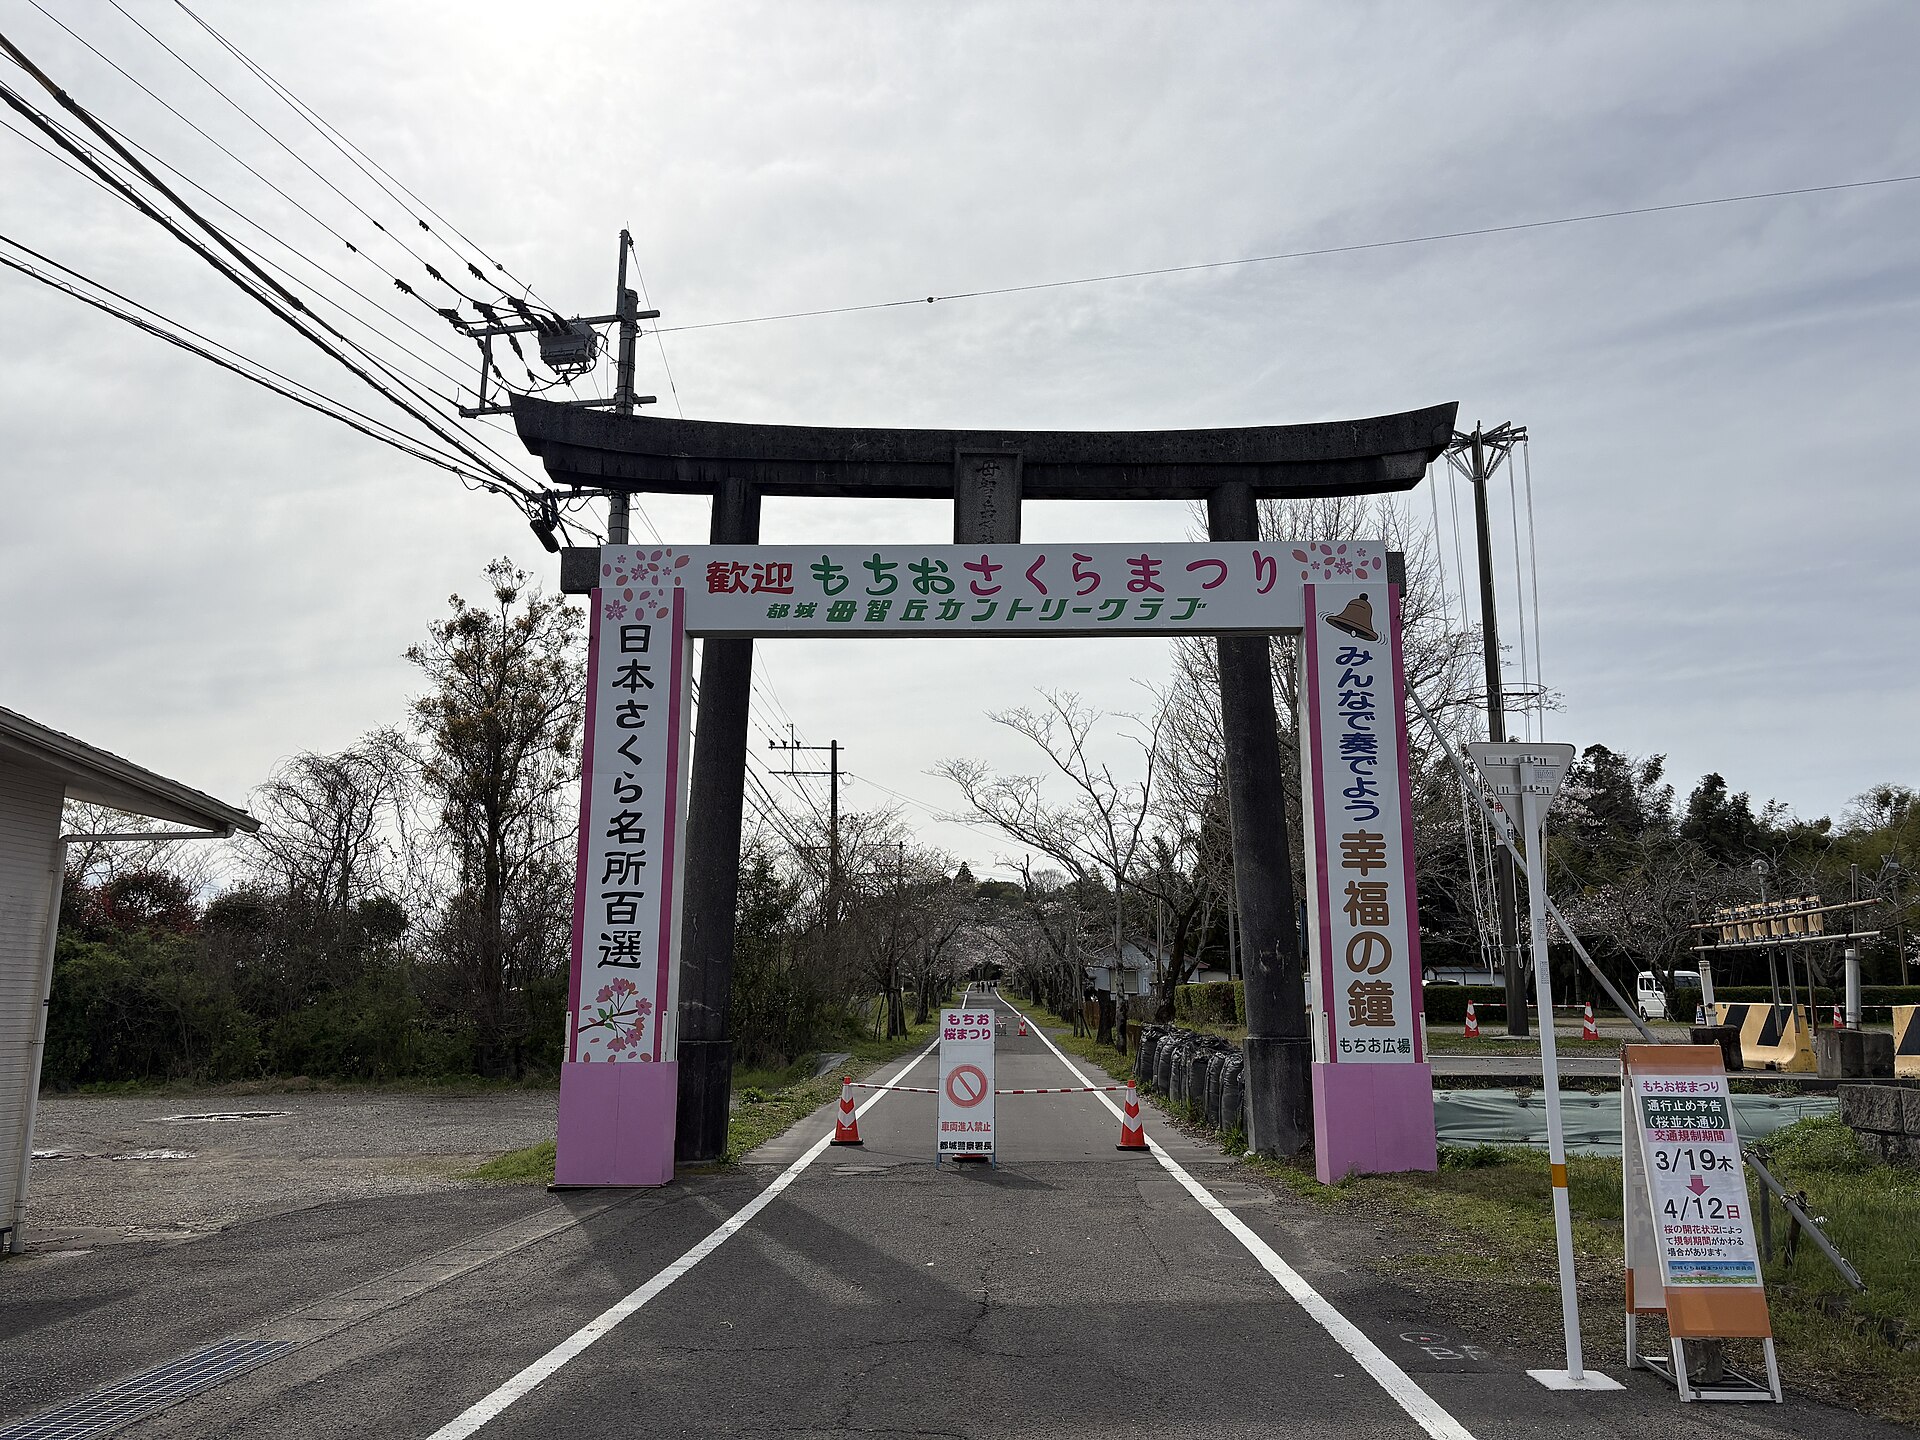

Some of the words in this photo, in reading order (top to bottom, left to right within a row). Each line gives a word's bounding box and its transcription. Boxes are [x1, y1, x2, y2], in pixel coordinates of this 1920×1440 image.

[597, 624, 655, 970] 日本さくら名所百選
[947, 1013, 990, 1026] もちお
[943, 1028, 991, 1041] 桜まつり
[1339, 1036, 1412, 1054] もちお広場
[1643, 1081, 1719, 1093] もちお桜まつり
[1647, 1099, 1722, 1112] 通行止め予告
[941, 1121, 992, 1133] 車両進入禁止
[1649, 1115, 1725, 1129] （桜並木通り）
[1654, 1130, 1725, 1142] 交通規制期間
[940, 1140, 992, 1151] 都城警察署長
[1664, 1224, 1743, 1235] 桜の開花状況によっ
[1666, 1236, 1744, 1246] て規制期間がかわる
[1667, 1247, 1727, 1257] 場合があります。
